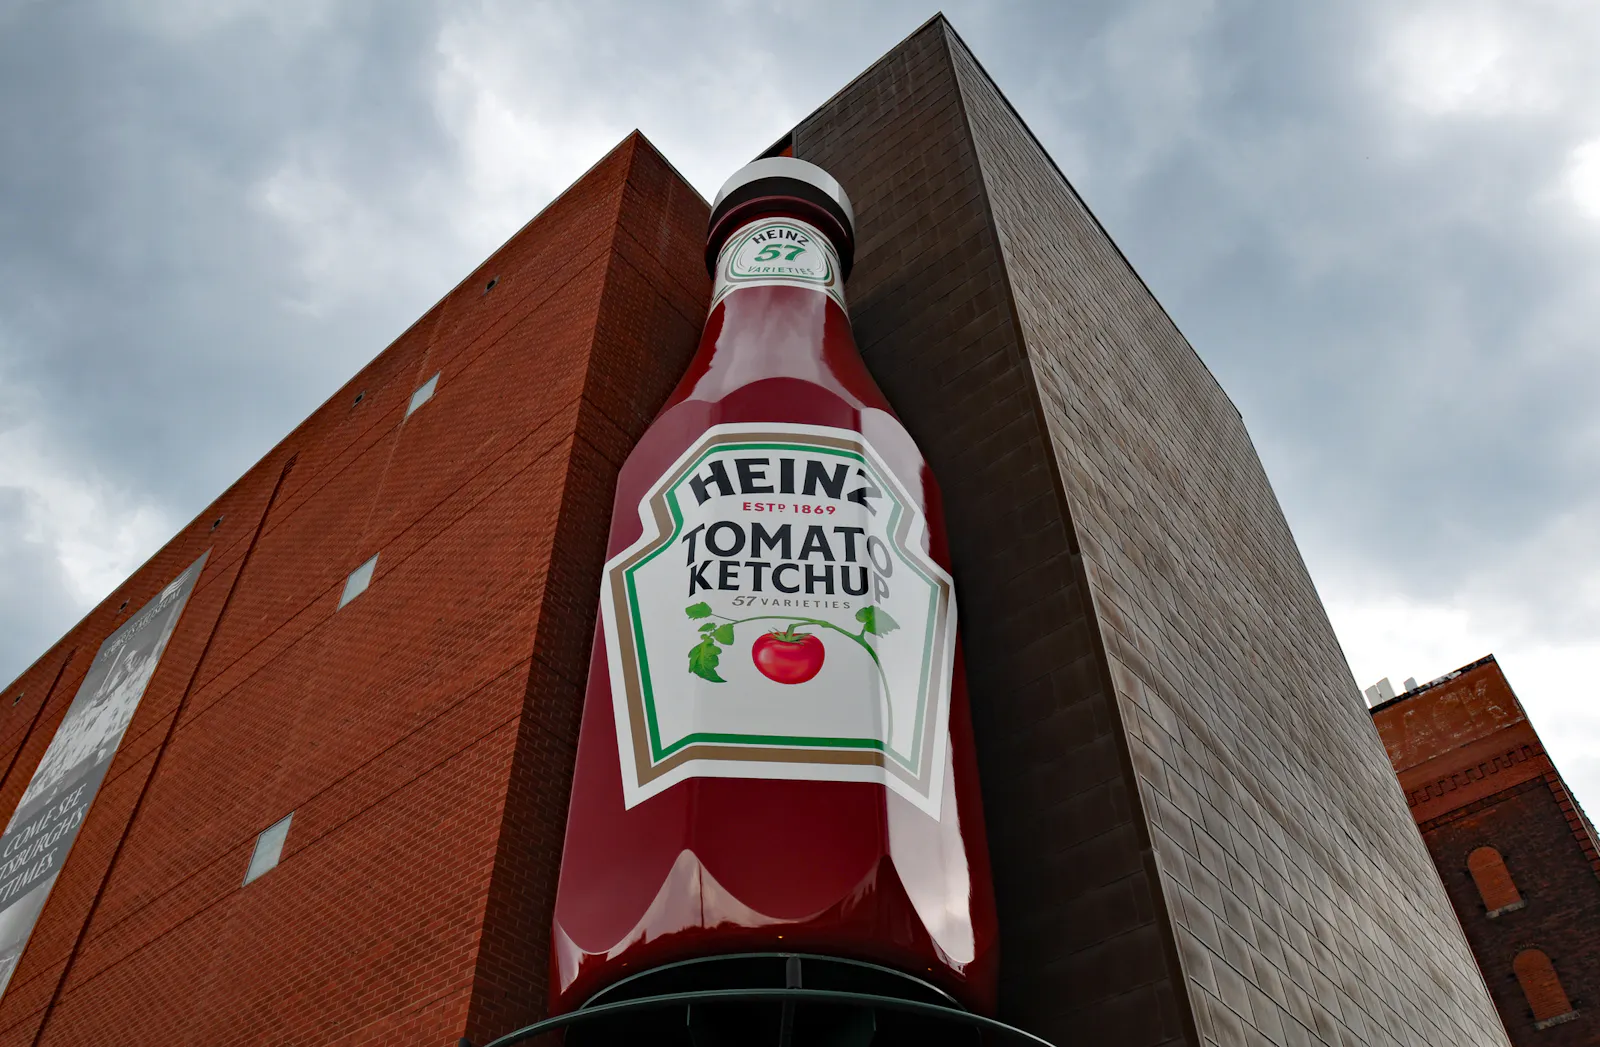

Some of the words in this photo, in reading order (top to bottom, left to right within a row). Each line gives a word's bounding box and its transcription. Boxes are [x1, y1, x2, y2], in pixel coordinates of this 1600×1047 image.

[752, 229, 810, 247] HEINZ
[754, 244, 806, 262] 57
[747, 266, 815, 276] VARIETIES
[688, 458, 883, 517] HEINZ
[792, 504, 836, 515] 1869
[681, 520, 893, 579] TOMATO
[688, 560, 890, 605] KETCHUP
[731, 596, 757, 607] 57
[761, 598, 851, 610] VARIETIES
[3, 806, 57, 858] COME
[53, 783, 88, 821] SEE
